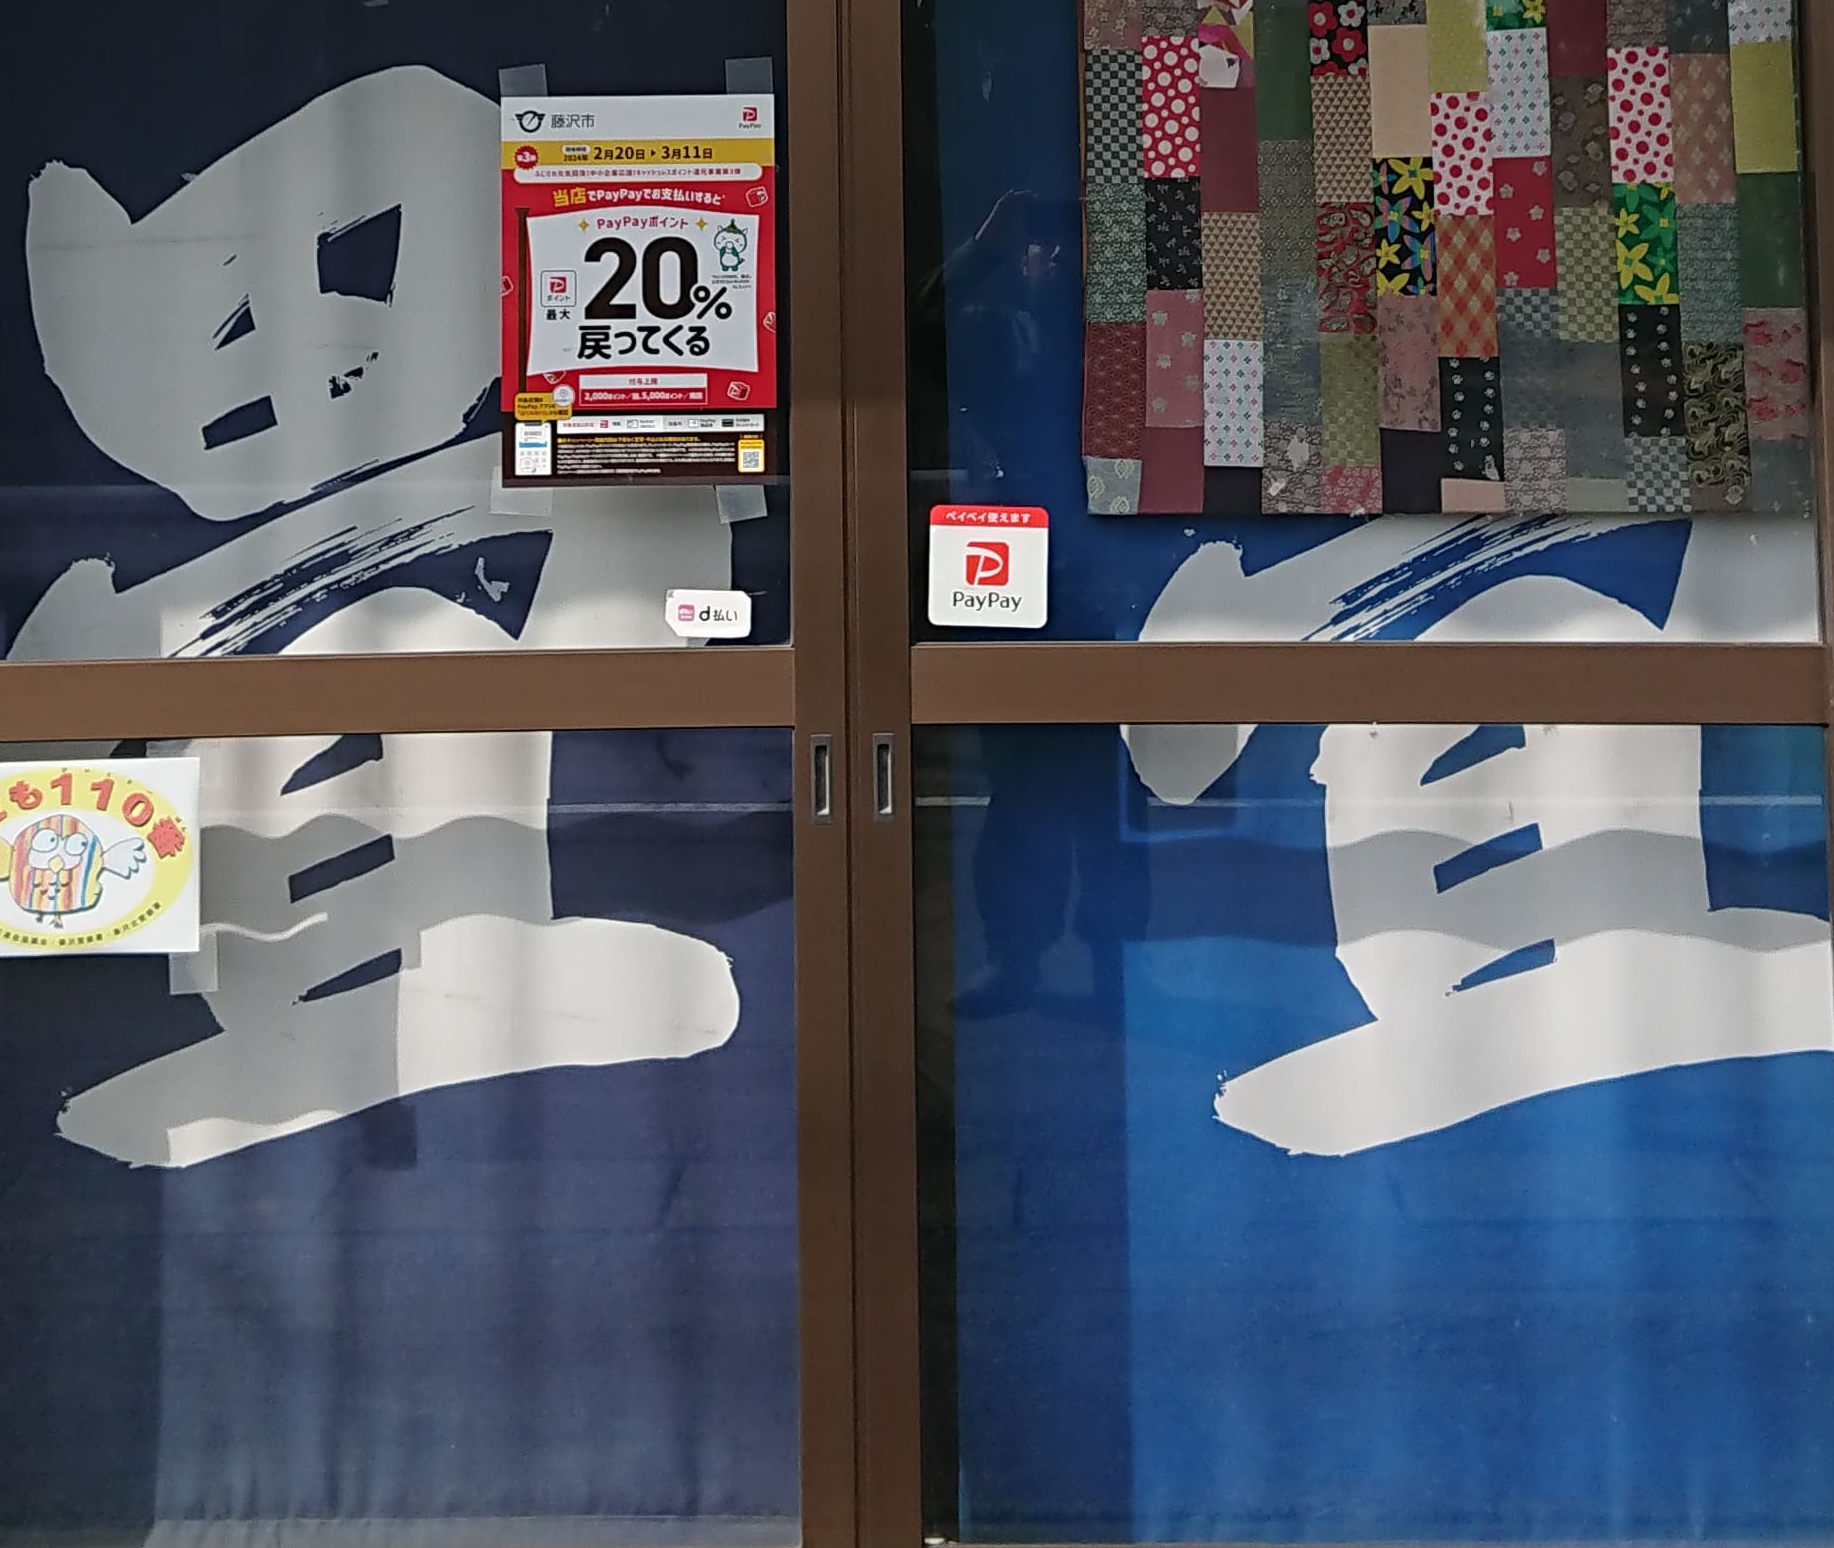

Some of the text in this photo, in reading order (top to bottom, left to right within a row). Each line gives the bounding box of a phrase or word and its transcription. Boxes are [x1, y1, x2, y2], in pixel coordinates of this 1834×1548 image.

[551, 113, 595, 129] 藤沢市
[593, 145, 713, 161] 2月20日 3月11日
[596, 215, 690, 231] PayPayポイント
[583, 235, 733, 321] 20%
[546, 294, 571, 302] ポイント
[546, 308, 571, 321] 最大
[577, 324, 711, 360] 戻ってくる
[945, 510, 1031, 524] ペイペイ使えます
[952, 591, 1023, 613] PayPay
[699, 605, 738, 621] d払い
